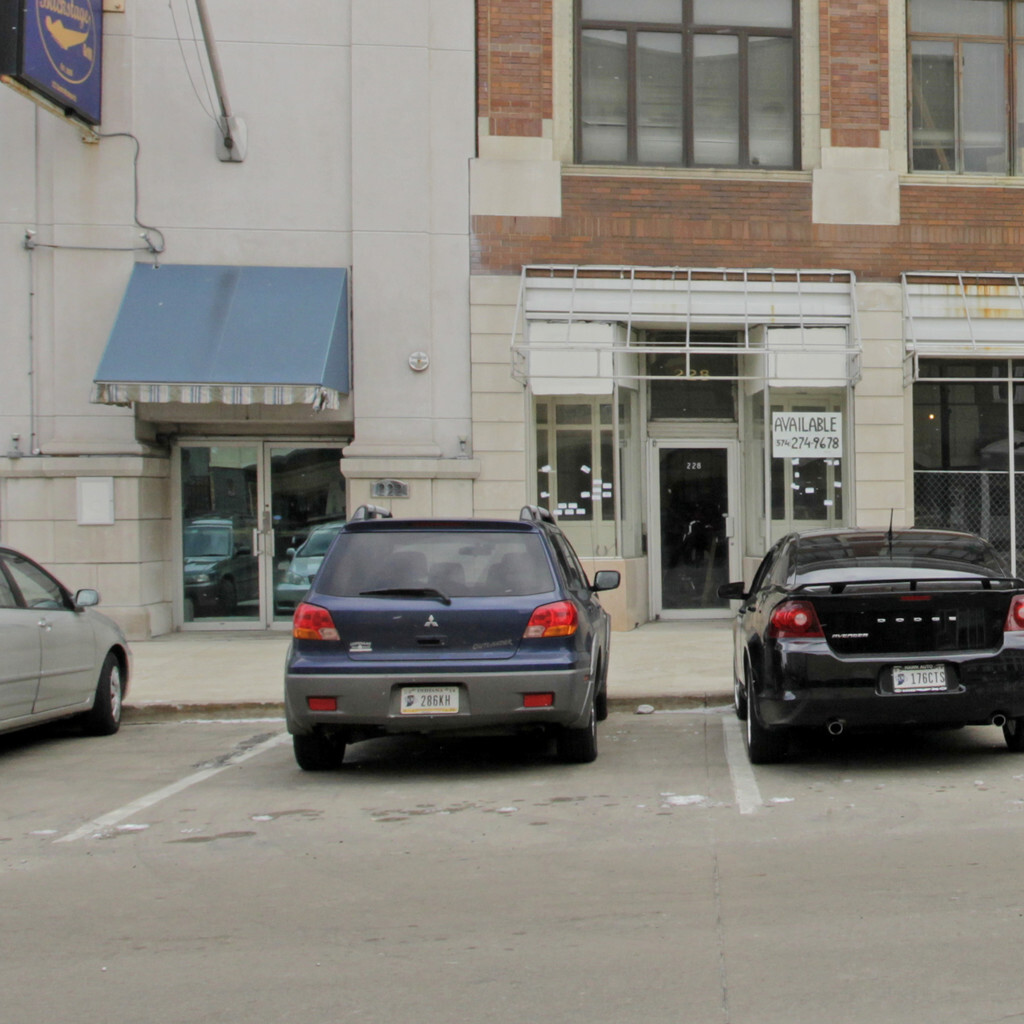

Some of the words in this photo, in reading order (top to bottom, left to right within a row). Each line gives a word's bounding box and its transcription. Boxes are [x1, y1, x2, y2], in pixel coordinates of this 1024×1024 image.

[774, 417, 837, 432] AVAILABLE
[686, 461, 702, 470] 228
[472, 639, 514, 650] OUTLANDER
[911, 672, 945, 684] 176CTS
[420, 694, 451, 707] 286KH
